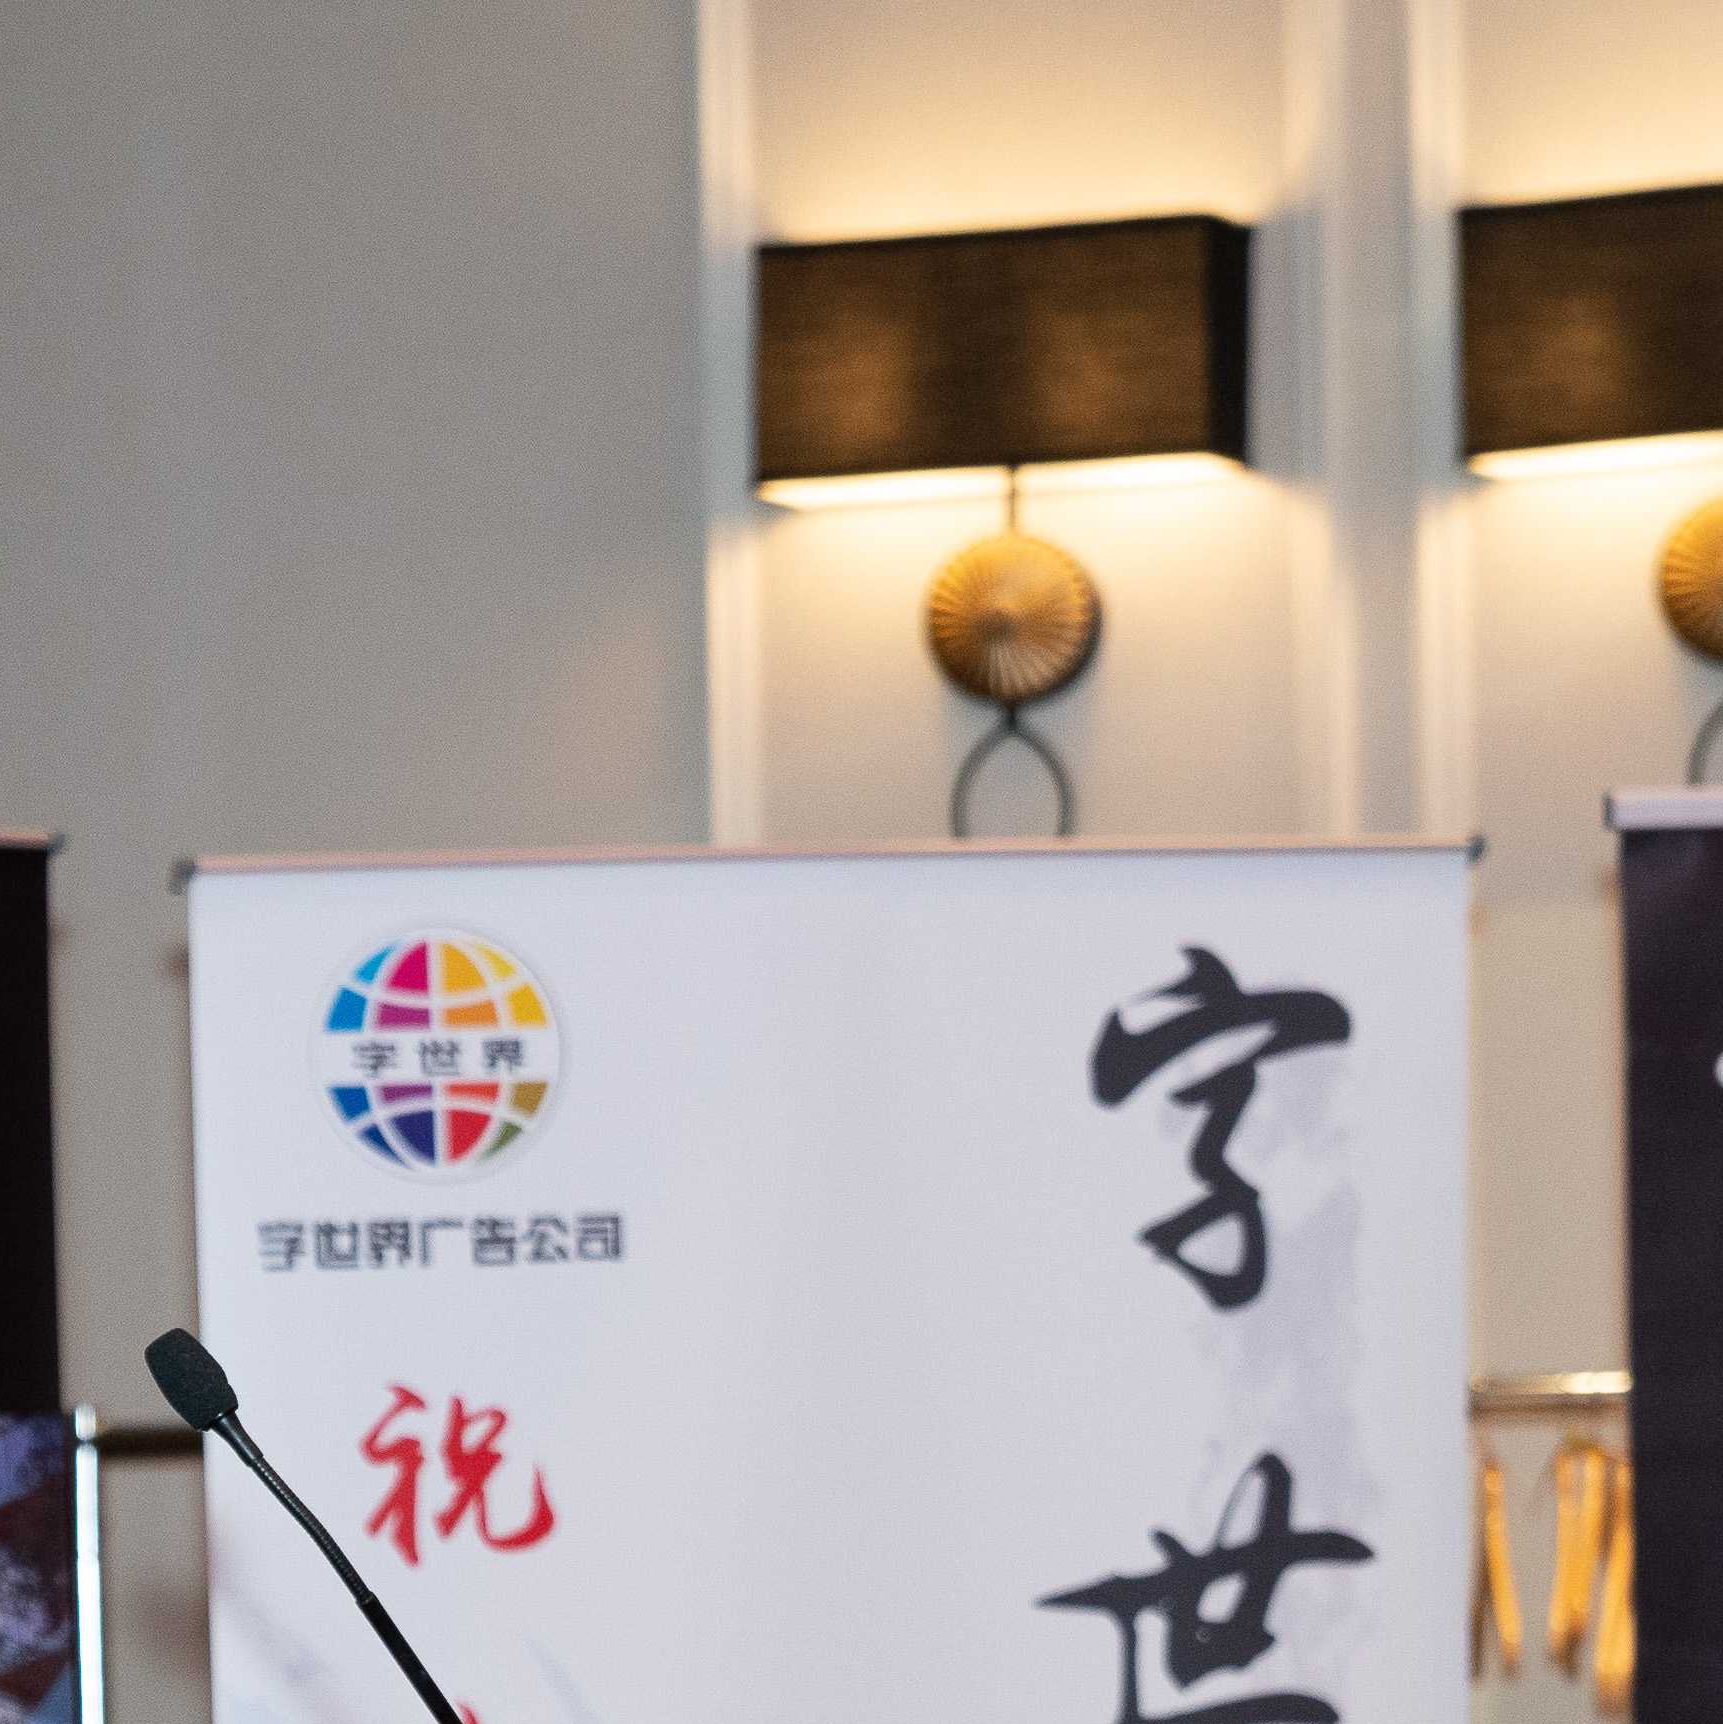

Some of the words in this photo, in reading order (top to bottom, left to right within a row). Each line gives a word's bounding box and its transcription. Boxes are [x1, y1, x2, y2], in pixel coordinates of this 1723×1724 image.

[350, 1037, 529, 1078] 字世界
[257, 1208, 627, 1274] 字世界广告公司
